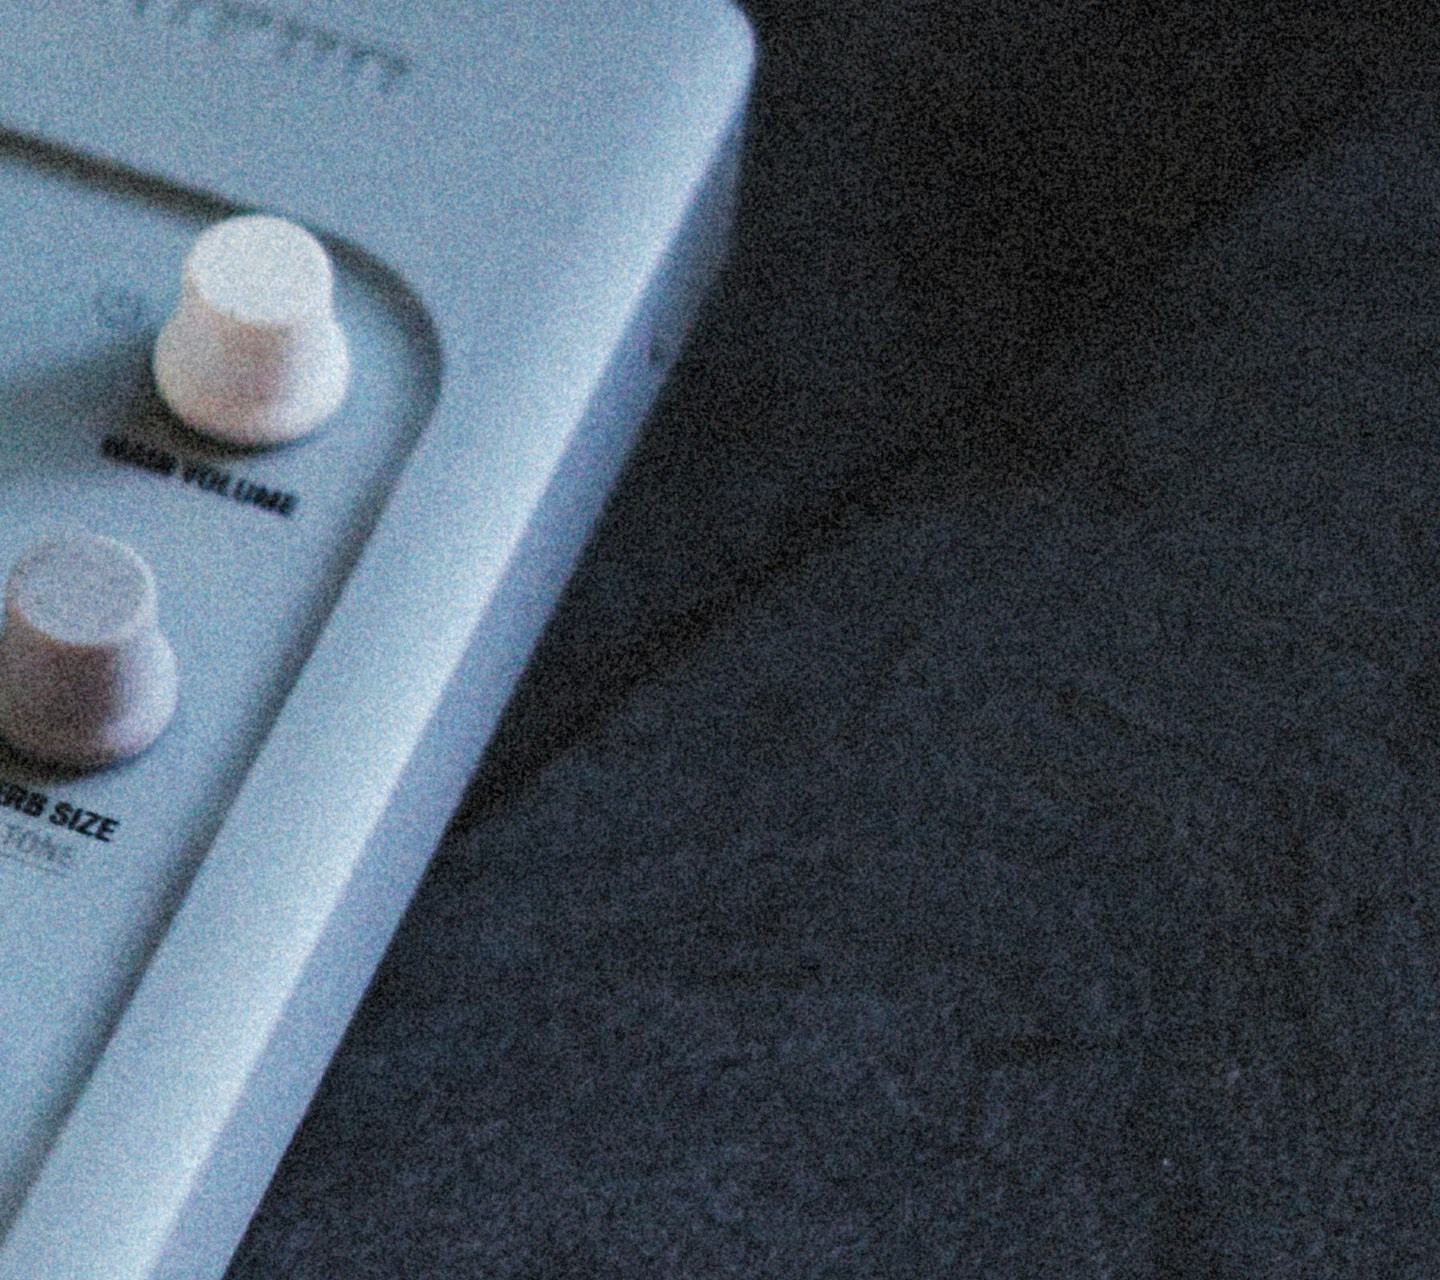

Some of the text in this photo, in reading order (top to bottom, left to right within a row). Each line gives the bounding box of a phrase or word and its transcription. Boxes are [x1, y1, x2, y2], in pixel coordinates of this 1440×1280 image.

[181, 458, 299, 519] VOLUME
[48, 801, 120, 844] SIZE
[2, 824, 76, 866] TONE
